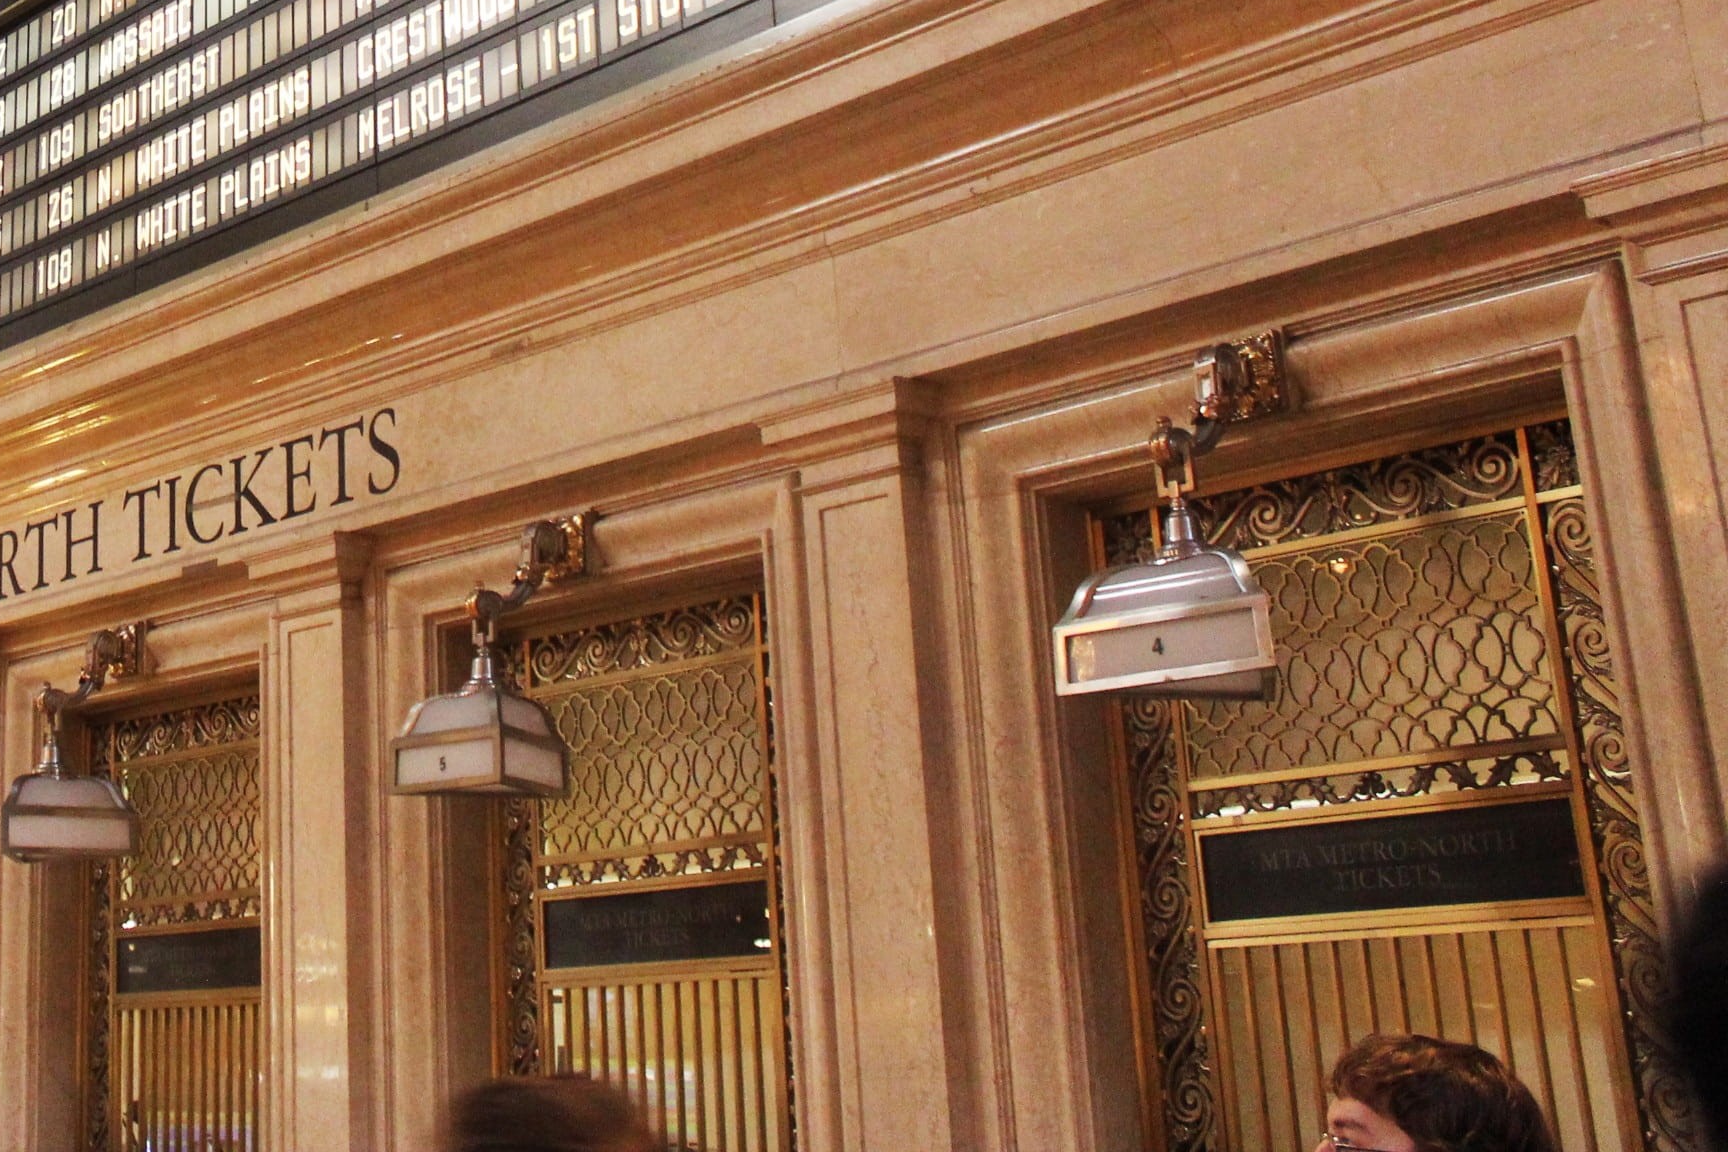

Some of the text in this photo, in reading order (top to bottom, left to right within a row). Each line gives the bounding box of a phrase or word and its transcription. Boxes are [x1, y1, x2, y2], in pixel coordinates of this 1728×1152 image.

[52, 2, 76, 46] 20
[40, 121, 73, 172] 109
[98, 45, 219, 141] SOUTHEAST
[51, 58, 75, 106] 28
[37, 247, 72, 295] 108
[96, 231, 119, 268] N.
[137, 184, 206, 251] WHITE
[220, 138, 311, 215] PLAINS
[358, 59, 482, 154] MELROSE
[542, 4, 596, 72] 1ST
[48, 184, 73, 229] 26
[98, 166, 122, 205] N.
[137, 116, 206, 185] WHITE
[220, 68, 310, 147] PLAINS
[123, 406, 402, 562] TICKETS
[1152, 637, 1164, 655] 4
[439, 756, 447, 772] 5
